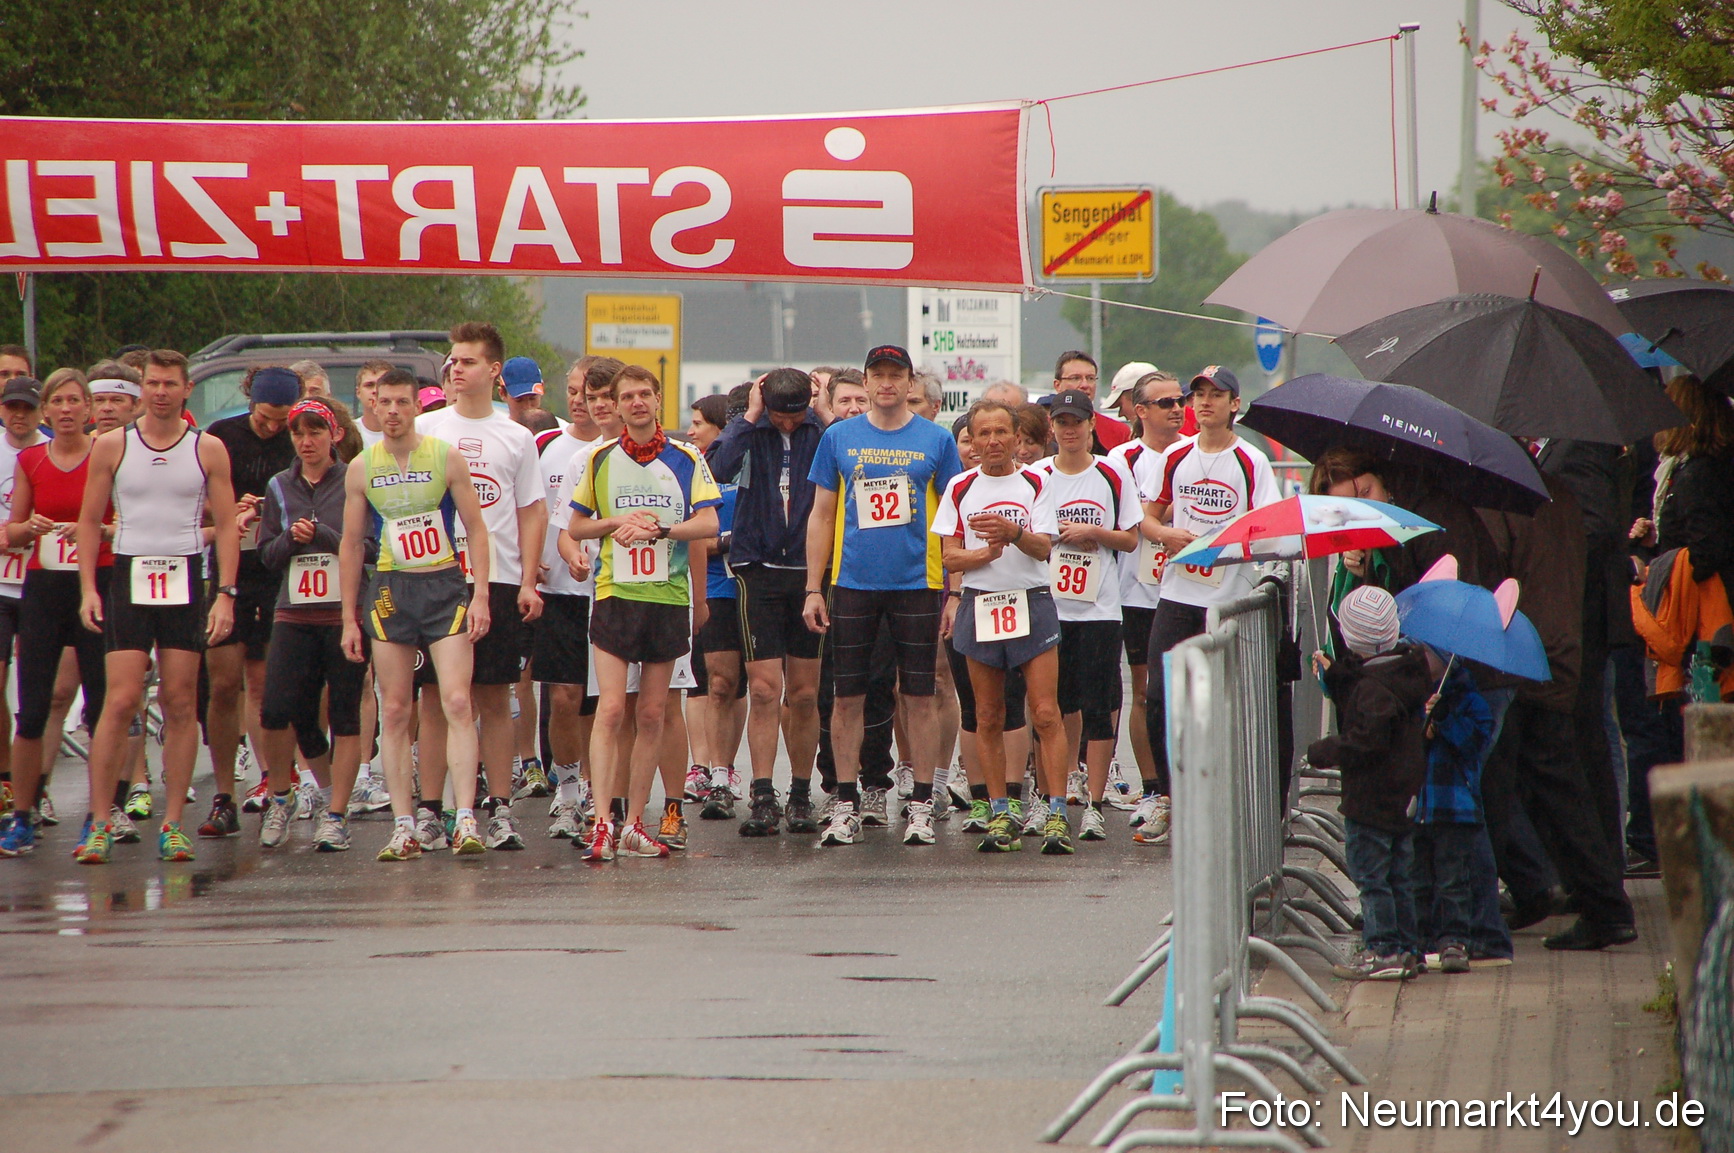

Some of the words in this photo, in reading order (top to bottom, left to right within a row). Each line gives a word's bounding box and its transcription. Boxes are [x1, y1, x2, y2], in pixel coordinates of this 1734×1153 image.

[933, 330, 954, 352] SHB
[847, 449, 859, 457] 10.
[860, 448, 925, 461] NEUMARKTER
[857, 456, 912, 466] STADTLAUF
[371, 471, 432, 488] BOCK
[863, 479, 887, 488] MEYER
[617, 485, 652, 495] TEAM
[1179, 485, 1225, 498] GERHART
[616, 495, 671, 509] BOCK
[870, 492, 900, 521] 32
[1197, 497, 1232, 508] JANIG
[397, 517, 421, 527] MEYER
[398, 527, 440, 560] 100
[297, 555, 318, 563] MEYER
[628, 547, 655, 576] 10
[1059, 552, 1082, 560] MEYER
[147, 572, 168, 599] 11
[298, 569, 328, 598] 40
[1057, 565, 1087, 594] 39
[982, 594, 1007, 603] MEYER
[990, 606, 1016, 635] 18
